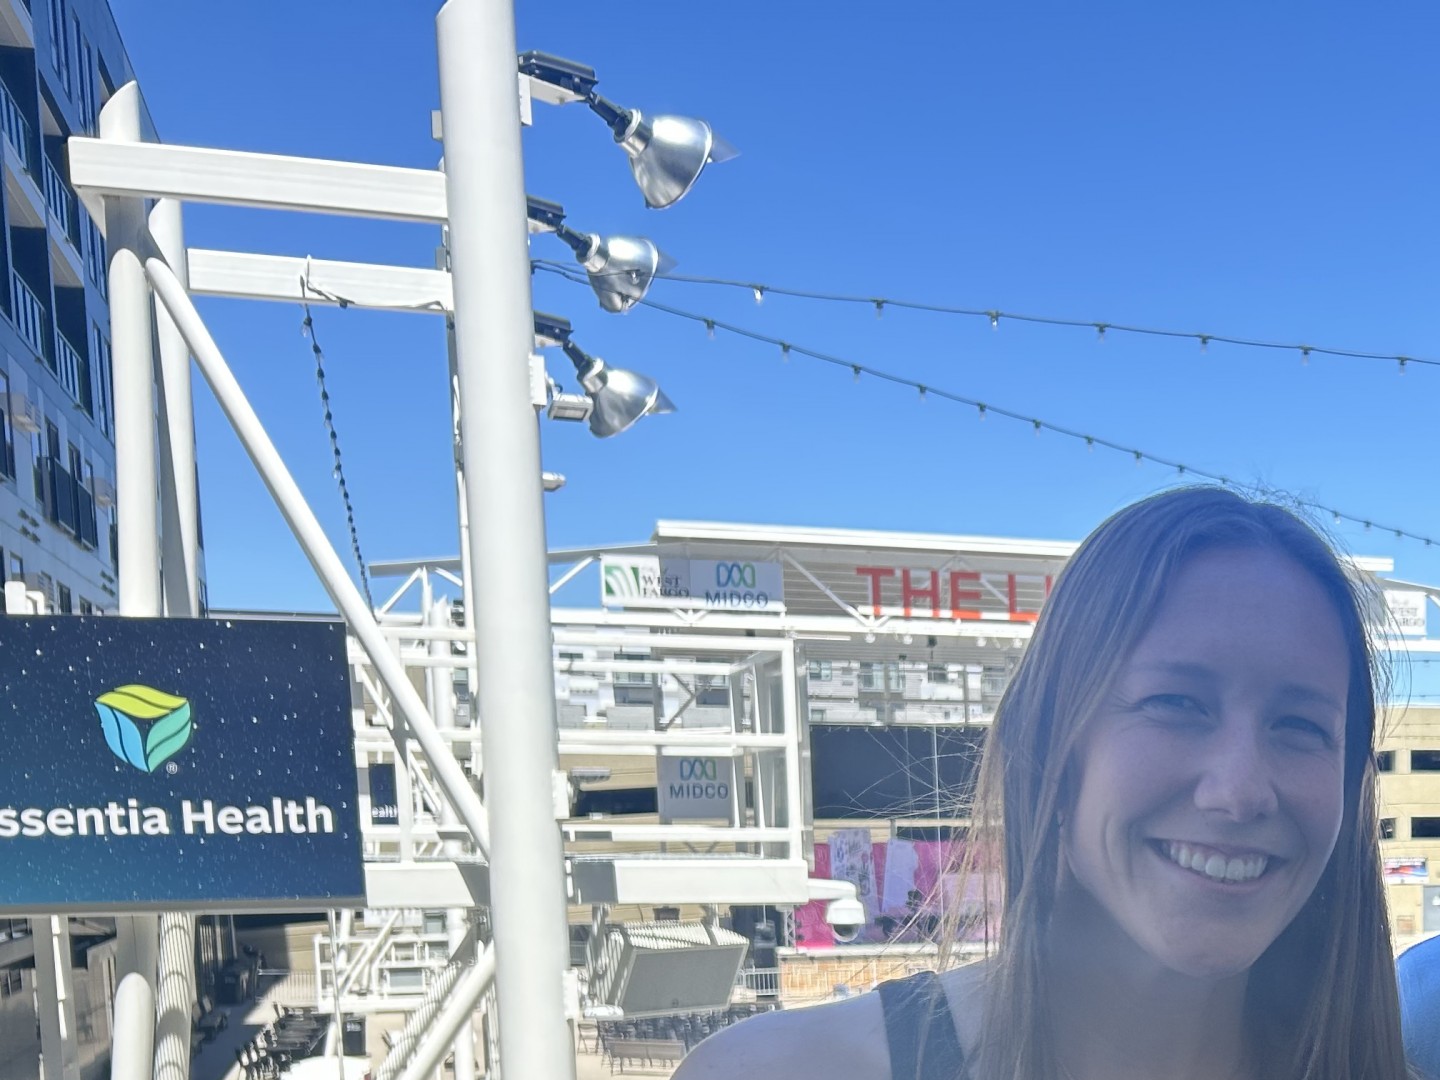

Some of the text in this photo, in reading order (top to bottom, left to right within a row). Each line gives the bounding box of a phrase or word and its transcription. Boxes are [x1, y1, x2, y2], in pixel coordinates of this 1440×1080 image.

[642, 575, 681, 587] WEST
[642, 586, 690, 599] FARGO
[705, 590, 769, 608] MIDCO
[856, 567, 982, 620] THE
[669, 782, 729, 800] MIDCO
[0, 796, 334, 837] ssentia Health
